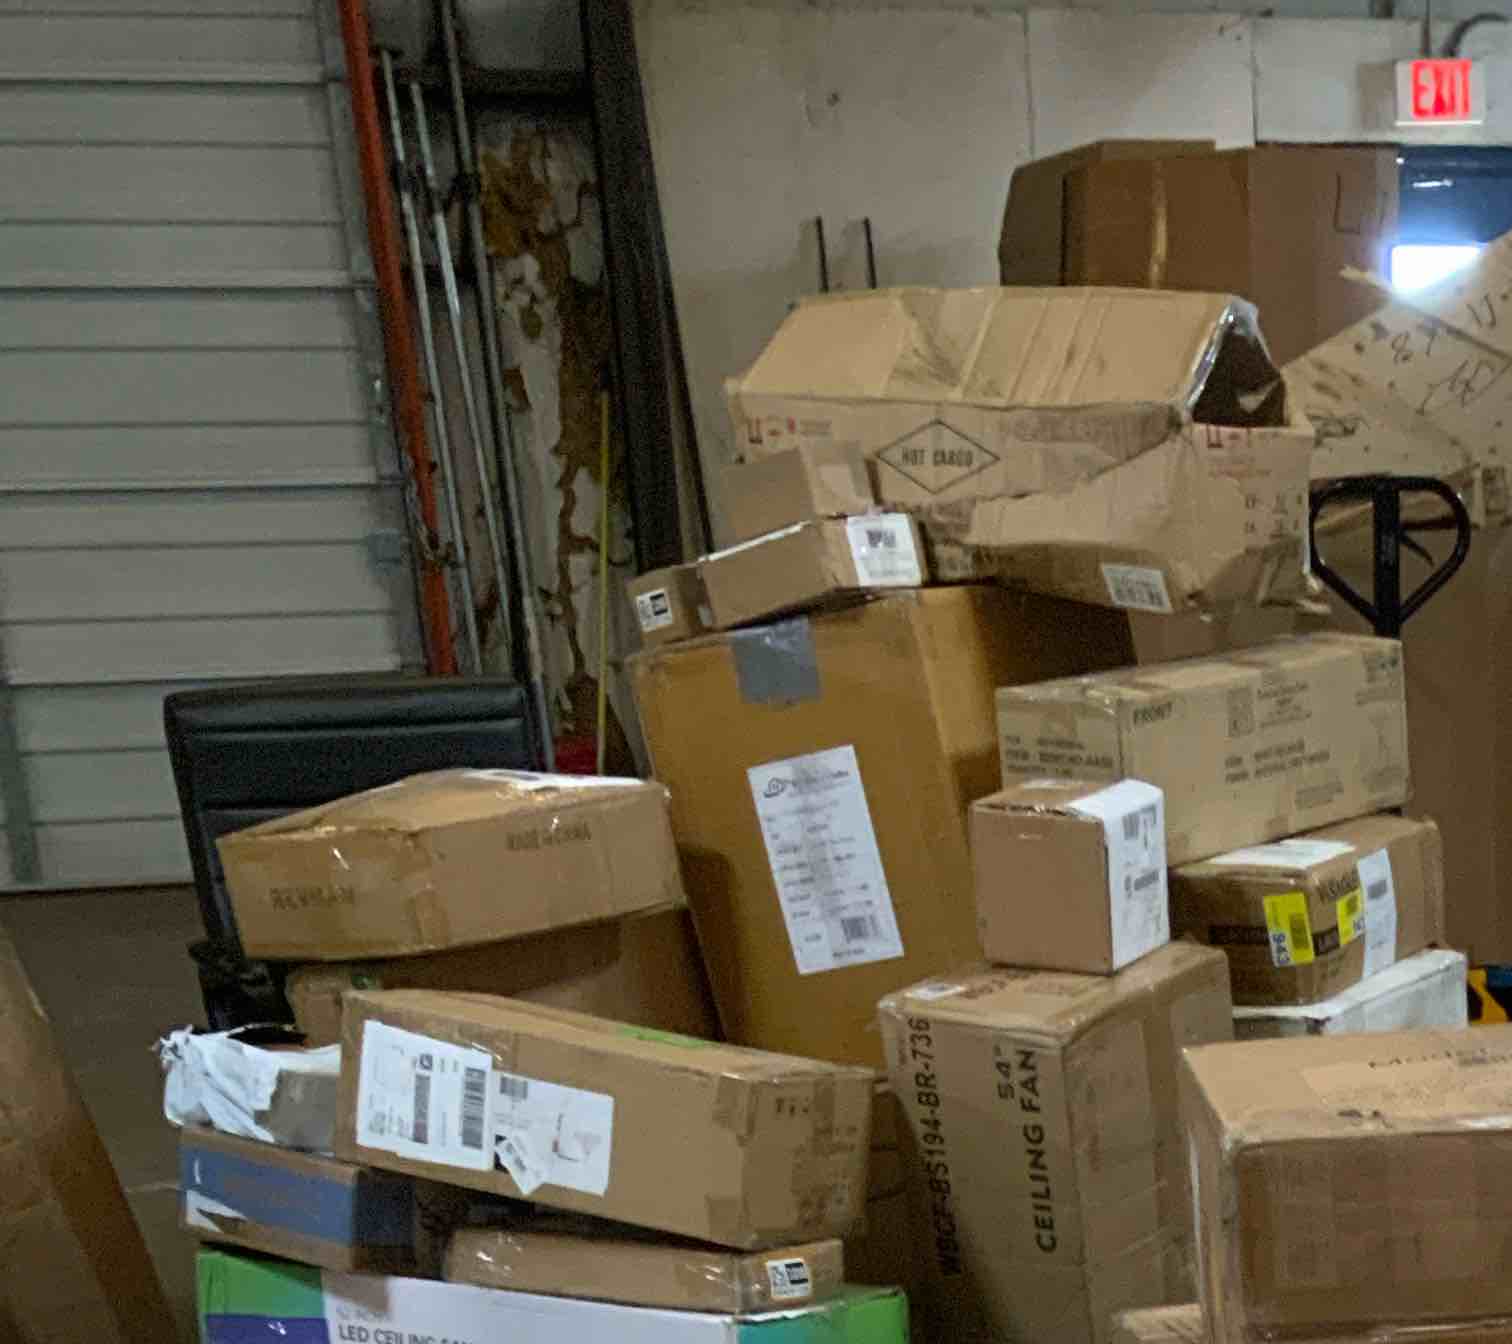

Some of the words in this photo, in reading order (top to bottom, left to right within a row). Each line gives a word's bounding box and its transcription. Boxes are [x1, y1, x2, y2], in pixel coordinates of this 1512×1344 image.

[1411, 60, 1471, 118] EXIT
[1016, 1049, 1042, 1114] FAN
[1023, 1124, 1057, 1253] CEILING
[338, 1324, 369, 1343] LED
